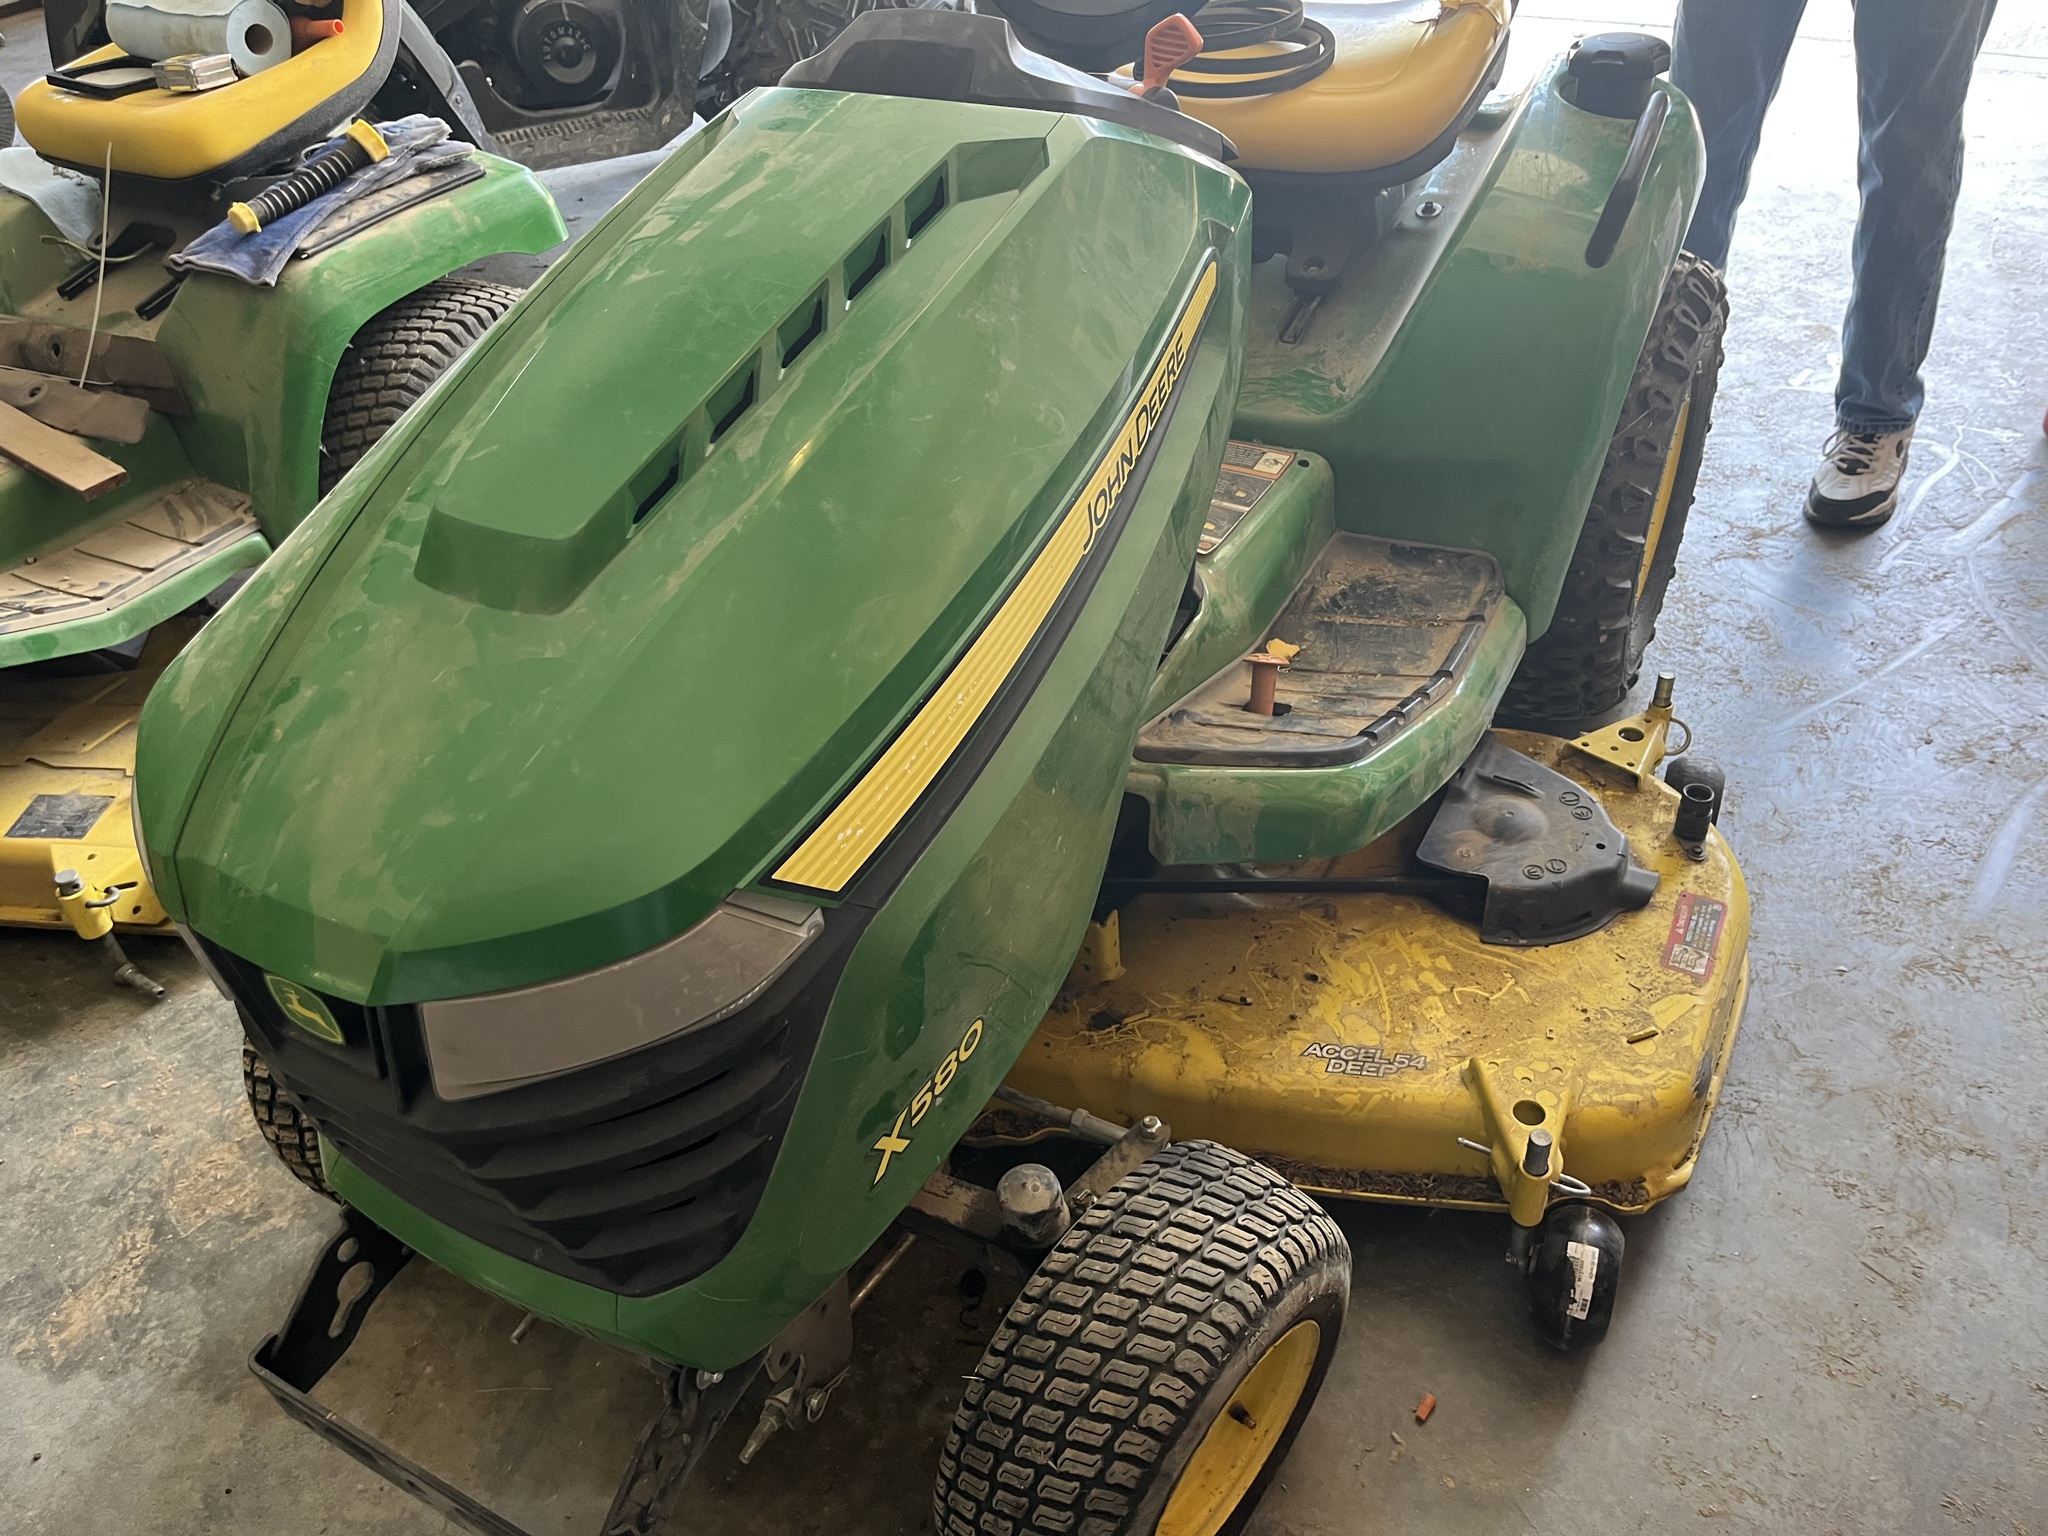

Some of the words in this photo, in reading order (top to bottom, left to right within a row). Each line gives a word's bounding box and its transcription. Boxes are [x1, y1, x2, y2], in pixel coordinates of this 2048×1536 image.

[542, 26, 591, 61] AUTOMATIC
[1083, 437, 1137, 554] JOHN
[1135, 331, 1187, 456] DEERE
[1301, 1042, 1390, 1064] ACCEL
[1394, 1053, 1427, 1070] 54
[1325, 1058, 1399, 1078] DEEP
[871, 1017, 984, 1191] X580
